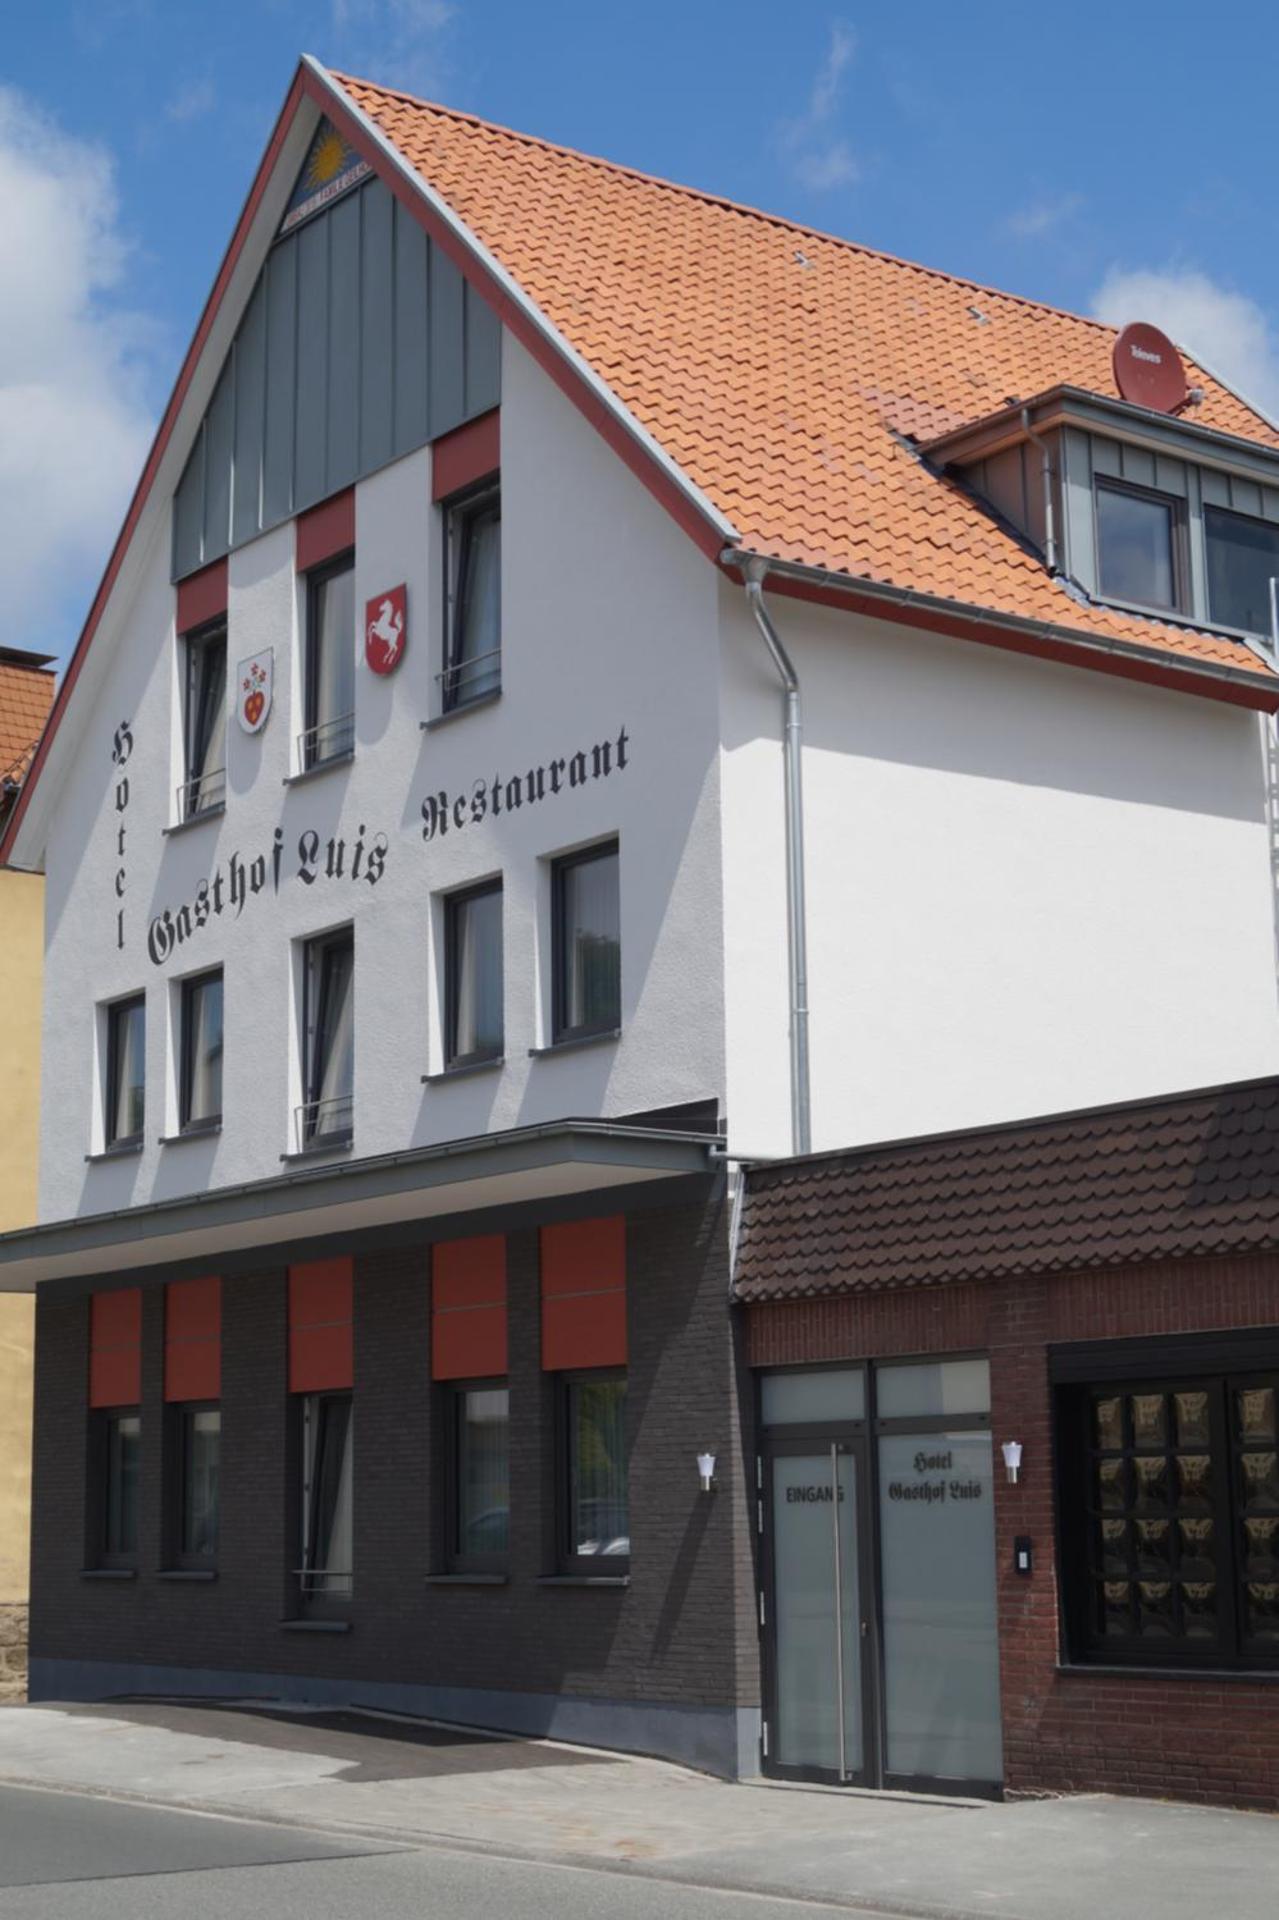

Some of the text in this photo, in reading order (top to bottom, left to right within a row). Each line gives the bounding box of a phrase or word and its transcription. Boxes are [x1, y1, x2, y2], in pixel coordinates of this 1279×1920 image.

[421, 723, 629, 842] Restaurant
[112, 720, 133, 950] Hotel
[148, 824, 389, 966] Gasthof Luis
[786, 1485, 845, 1503] EINGANG
[888, 1480, 982, 1503] Gasthof Luis
[913, 1451, 952, 1473] Hotel
